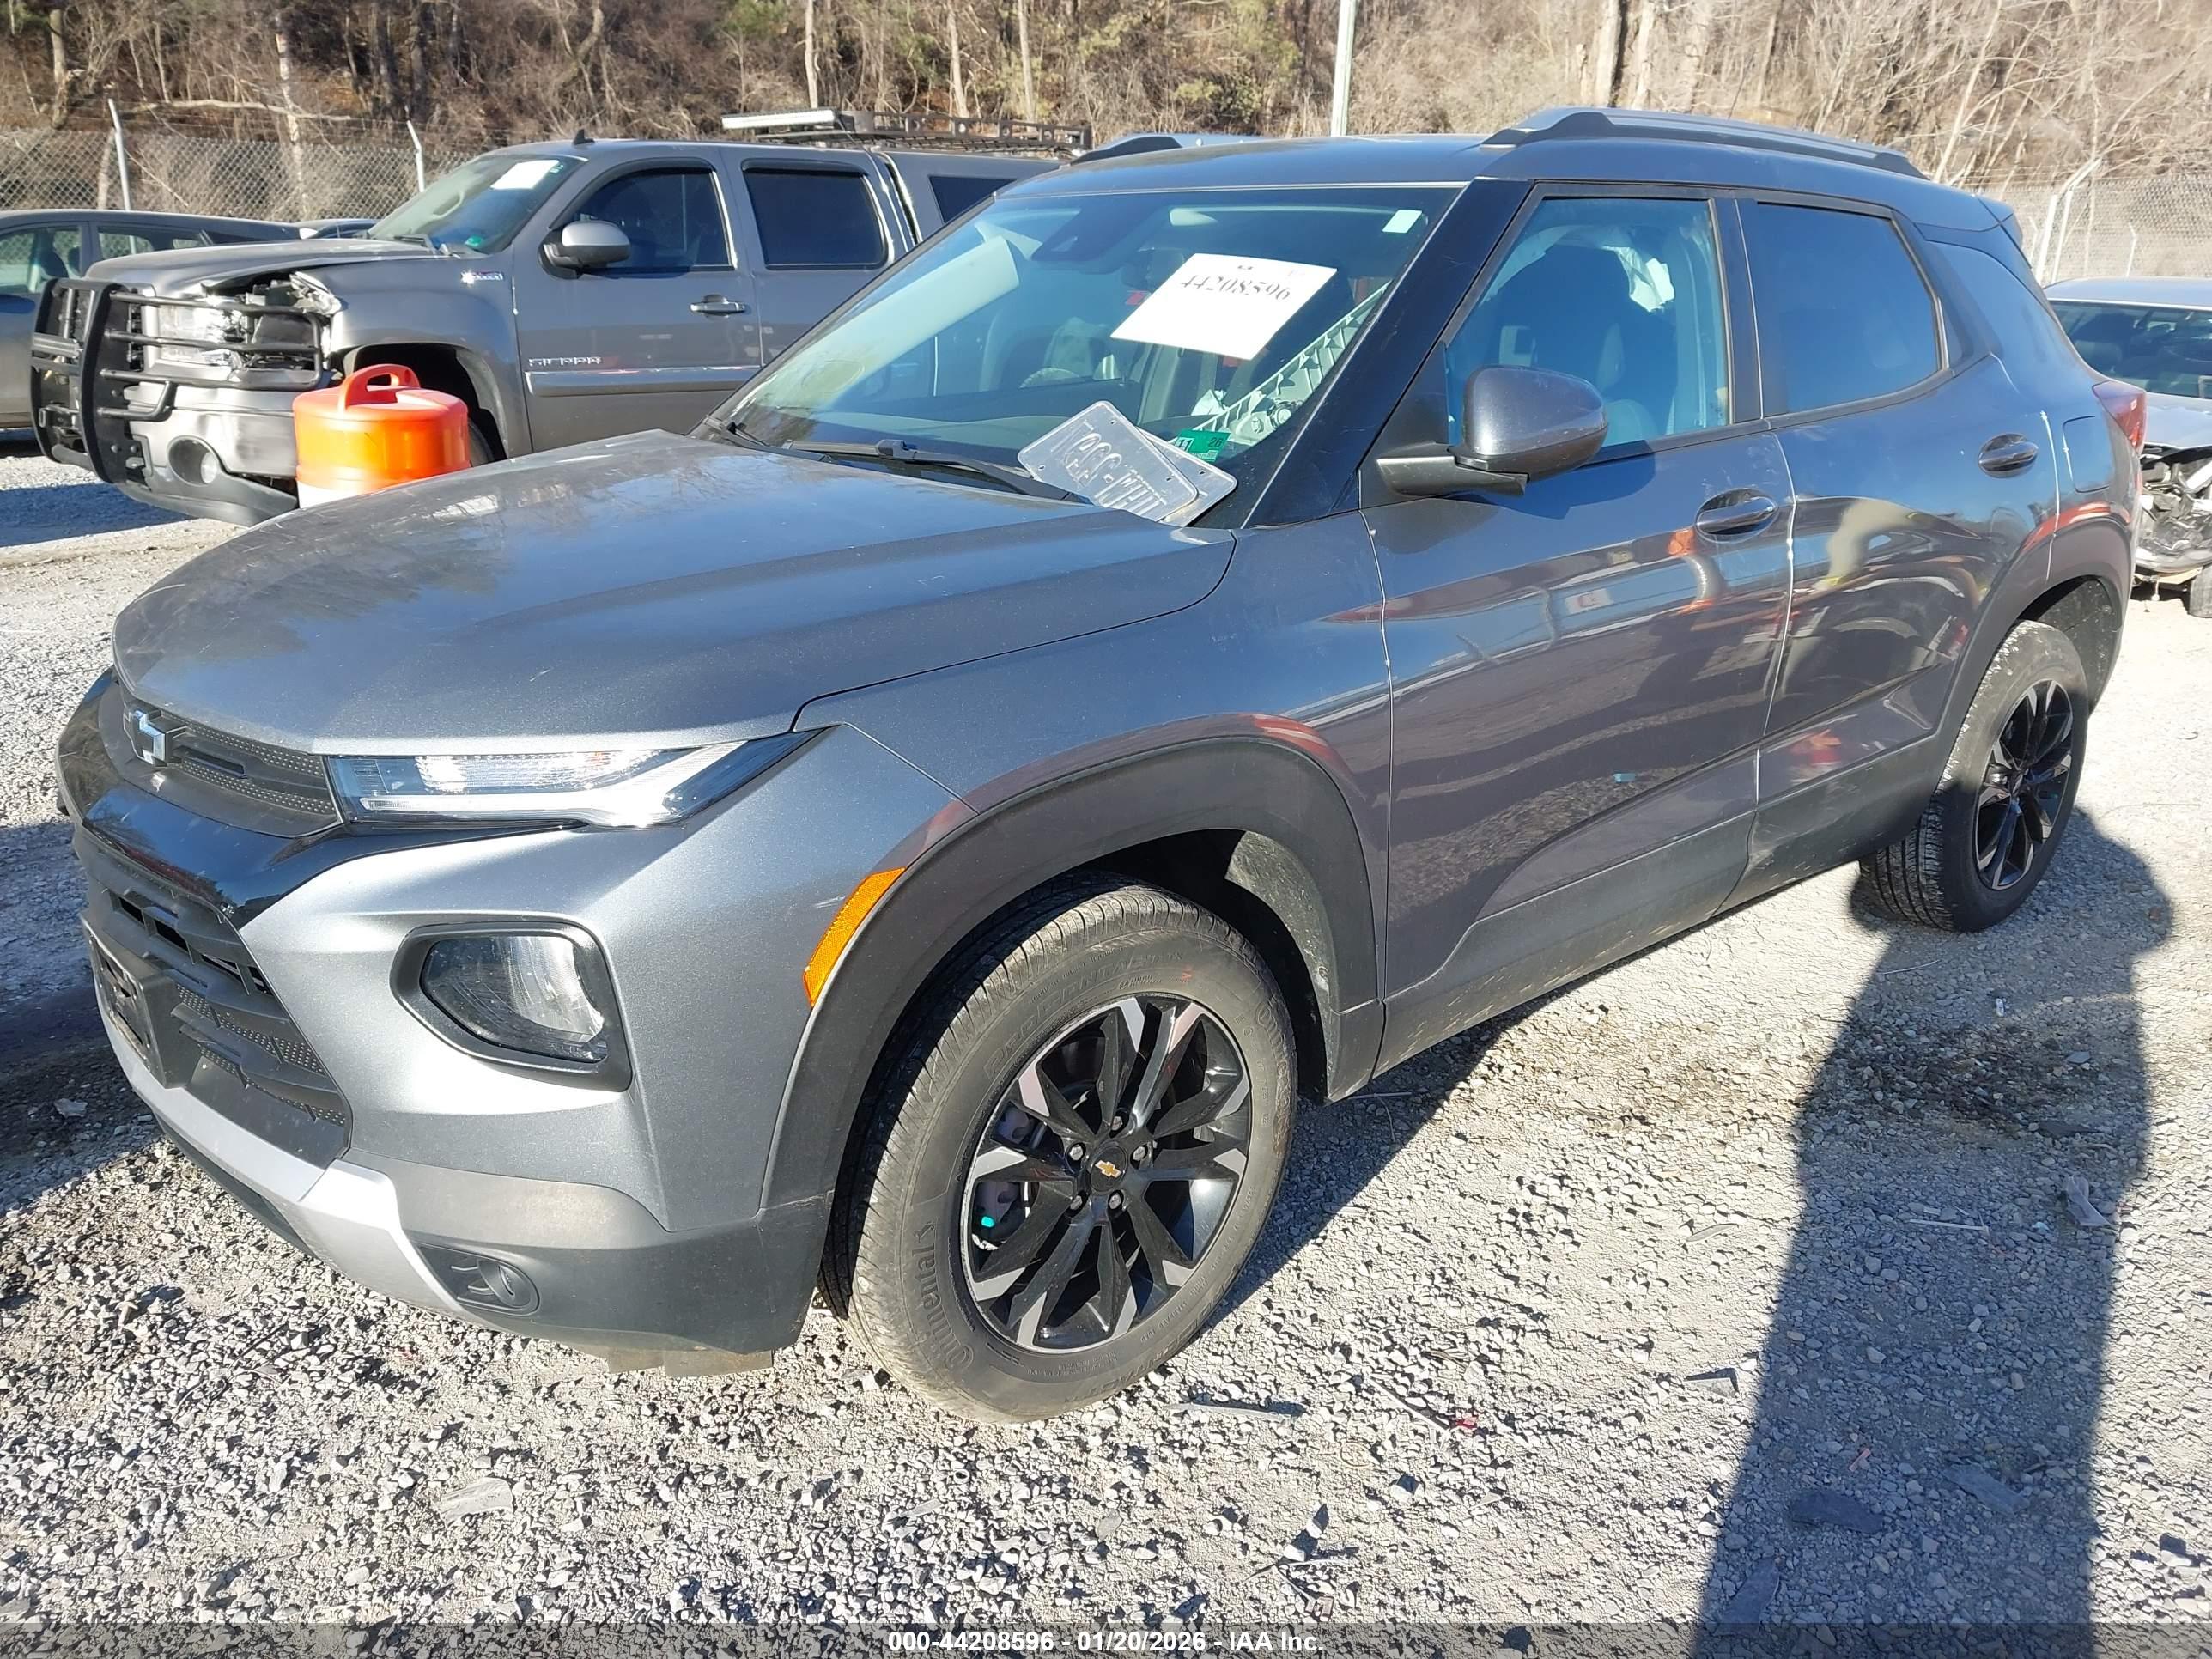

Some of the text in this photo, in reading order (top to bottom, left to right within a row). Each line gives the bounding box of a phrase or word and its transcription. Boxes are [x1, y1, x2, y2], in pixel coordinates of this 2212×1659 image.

[1181, 274, 1291, 301] 44208596
[1208, 437, 1224, 447] 26
[912, 1243, 975, 1374] Continental
